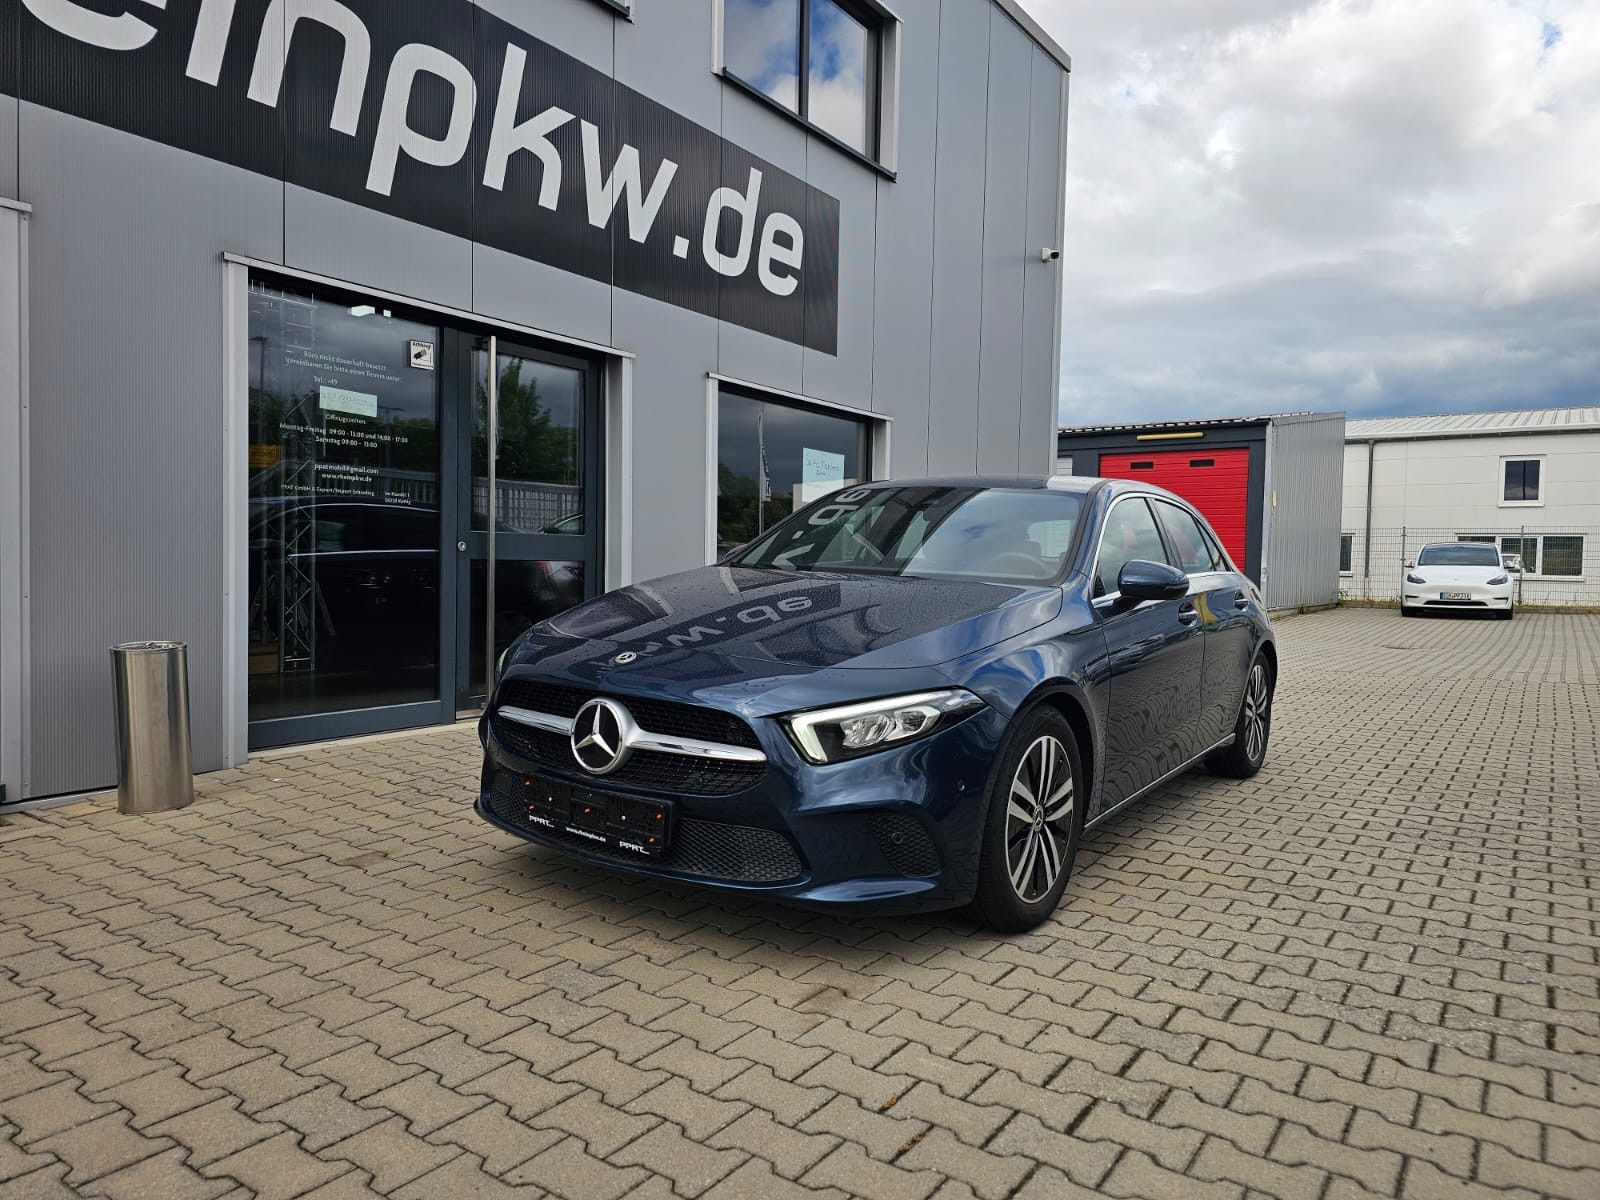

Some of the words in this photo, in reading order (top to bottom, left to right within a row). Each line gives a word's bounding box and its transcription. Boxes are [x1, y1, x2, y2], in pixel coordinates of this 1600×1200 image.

[320, 352, 335, 362] nicht
[334, 364, 348, 373] bitte
[366, 370, 384, 380] Termin
[328, 428, 346, 436] 09:00
[365, 432, 376, 440] und
[316, 436, 340, 446] Samstag
